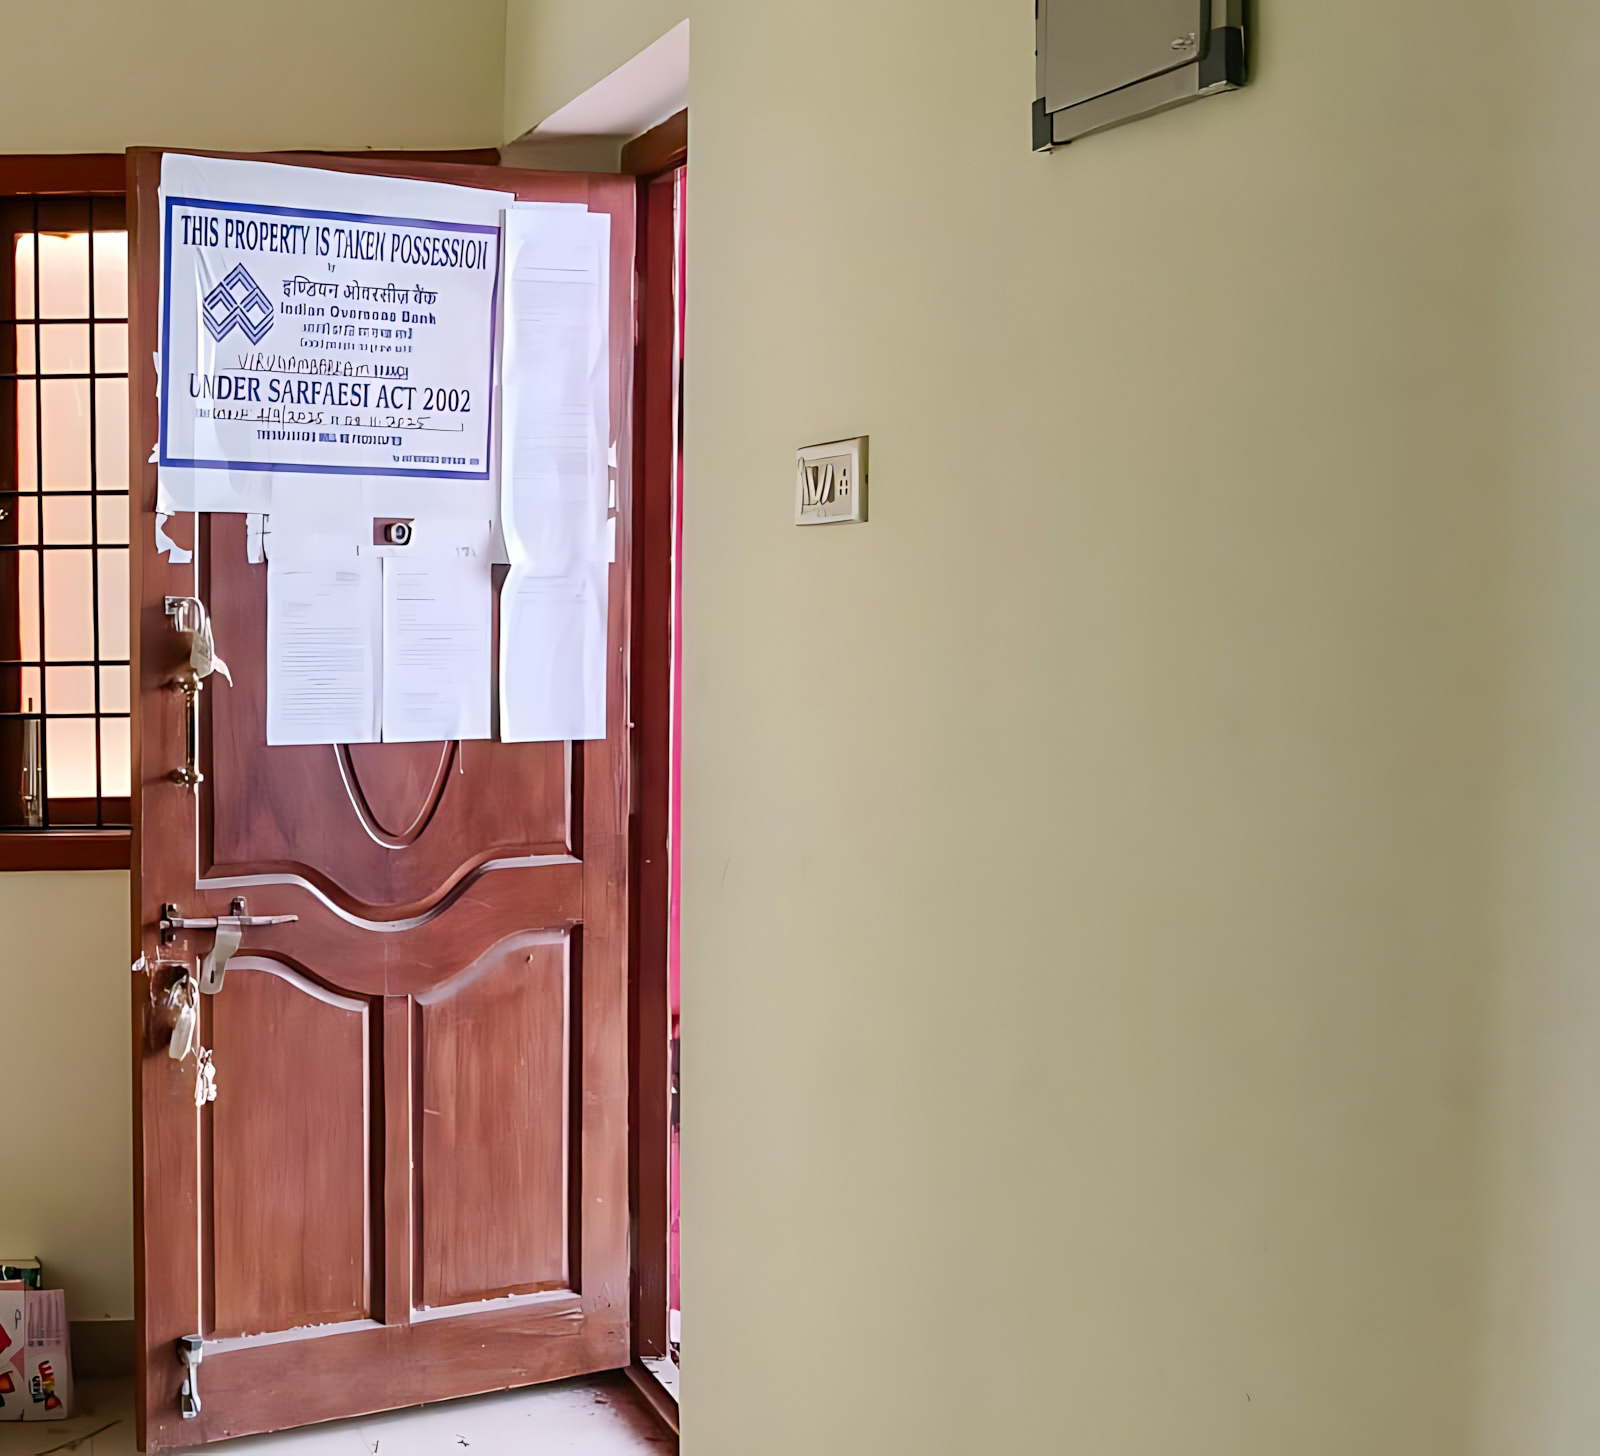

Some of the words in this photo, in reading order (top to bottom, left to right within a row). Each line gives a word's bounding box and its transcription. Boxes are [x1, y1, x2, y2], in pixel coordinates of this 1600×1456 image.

[181, 215, 219, 246] THIS
[225, 219, 310, 255] PROPERTY
[315, 227, 330, 257] IS
[334, 229, 386, 262] TAKEN
[390, 234, 488, 270] POSSESSION
[280, 302, 325, 317] Indian
[401, 311, 437, 325] Bank
[189, 373, 262, 402] UNDER
[268, 378, 371, 408] SARFAESI
[375, 384, 418, 411] ACT
[422, 387, 471, 413] 2002
